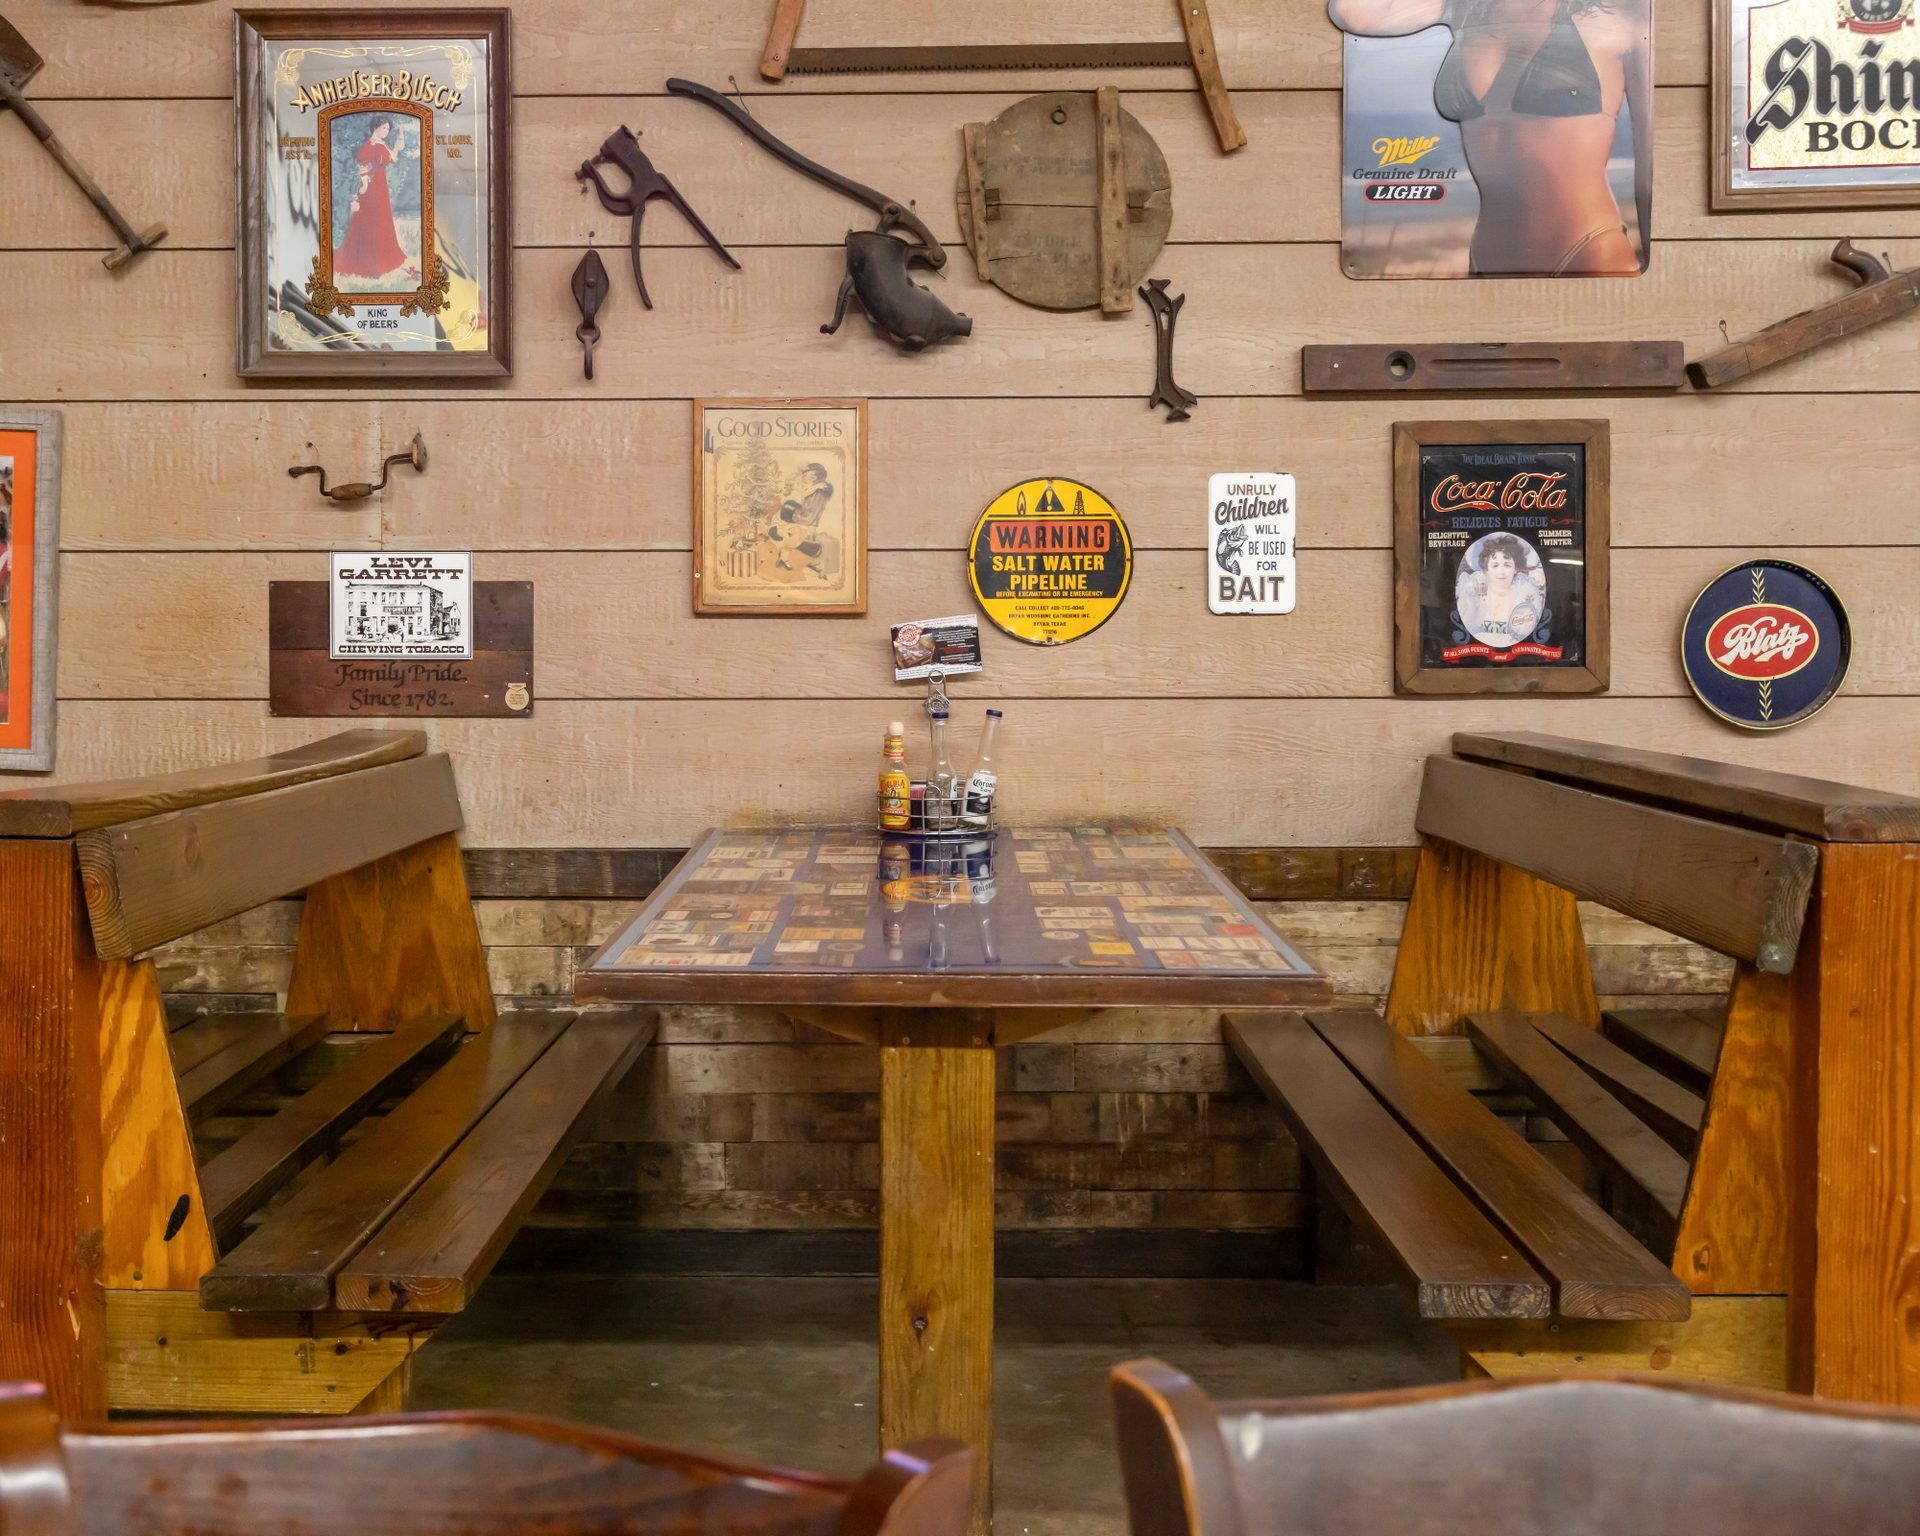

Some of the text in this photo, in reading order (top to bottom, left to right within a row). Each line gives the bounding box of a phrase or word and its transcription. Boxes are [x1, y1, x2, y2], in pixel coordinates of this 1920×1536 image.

[1804, 119, 1920, 152] BOC
[1372, 135, 1440, 168] Miller
[1353, 167, 1457, 180] Genuine Draft
[1373, 185, 1437, 199] LIGHT
[367, 308, 388, 318] KING
[357, 319, 398, 329] OF BEERS
[1227, 484, 1277, 496] UNRULY
[1431, 471, 1567, 513] Coca-Cola
[1214, 496, 1290, 526] Children
[1452, 516, 1549, 529] RELIEVES FATIGUE
[1254, 524, 1280, 535] WILL
[1428, 531, 1470, 539] DELIGHTFUL
[1538, 529, 1572, 538] SUMMER
[995, 525, 1105, 549] WARNING
[1543, 538, 1573, 546] WINTER
[1248, 541, 1287, 556] BE USED
[1428, 540, 1466, 548] BEVERAGE
[370, 557, 433, 568] LEVI
[992, 555, 1104, 572] SALT WATER
[1256, 560, 1278, 571] FOR
[339, 568, 464, 580] GARRETT
[1010, 574, 1087, 590] PIPELINE
[1218, 575, 1285, 602] BAIT
[1716, 616, 1809, 666] Blatz
[339, 645, 465, 654] CHEWING TOBACCO
[335, 661, 405, 688] Family
[349, 688, 455, 711] Since 1782.
